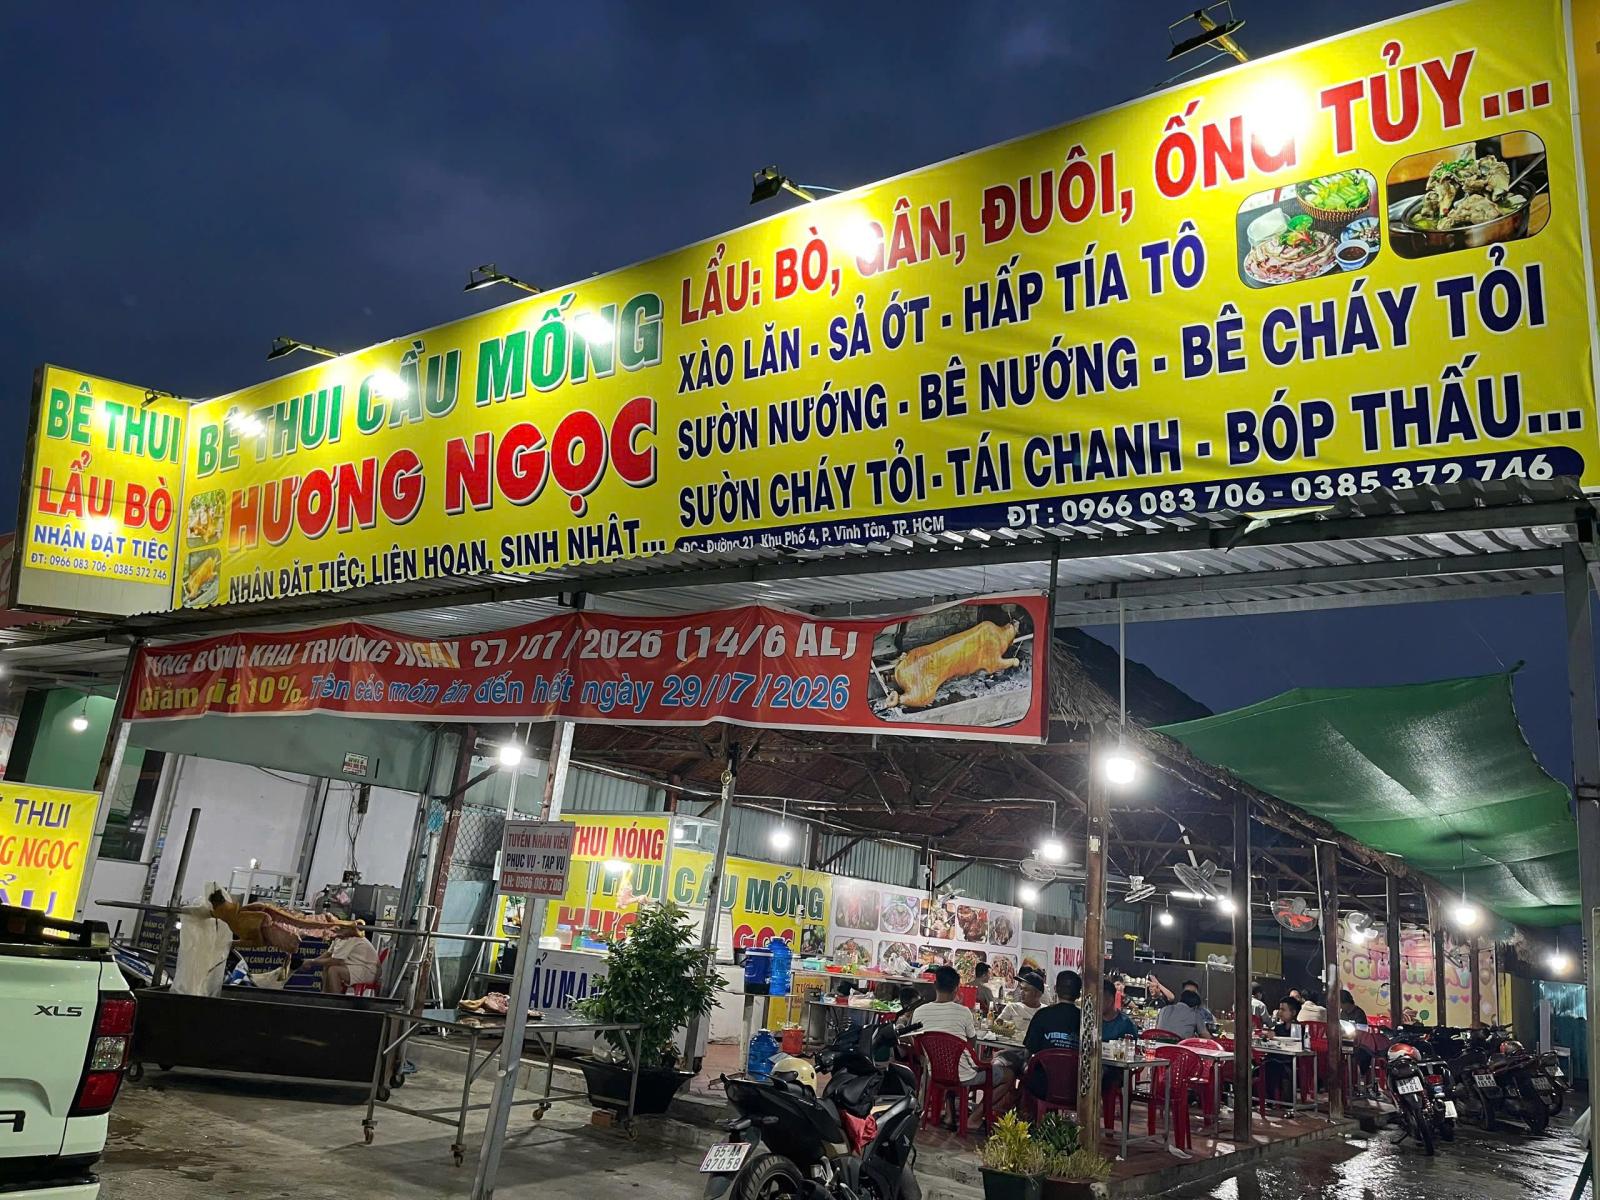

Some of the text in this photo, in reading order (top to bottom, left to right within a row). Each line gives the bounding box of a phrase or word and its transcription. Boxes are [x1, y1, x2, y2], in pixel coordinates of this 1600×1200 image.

[682, 242, 760, 326] LẨU:
[774, 225, 841, 297] BÒ,
[981, 144, 1134, 245] ĐUÔI,
[1320, 41, 1551, 154] TỦY...
[677, 339, 734, 394] XÀO
[744, 322, 801, 379] LĂN
[828, 295, 871, 361] SẢ
[881, 290, 931, 350] ỚT
[964, 254, 1044, 333] HẤP
[1055, 242, 1129, 314] TÍA
[1141, 219, 1206, 295] TÔ
[677, 401, 758, 461] SƯỜN
[768, 380, 888, 445] NƯỚNG
[920, 356, 968, 421] BÊ
[980, 335, 1139, 411] NƯỚNG
[1181, 303, 1247, 380] BÊ
[1261, 278, 1418, 367] CHÁY
[1436, 244, 1546, 339] TỎI
[197, 292, 663, 478] BÊ THUI CẦU MỐNG
[46, 380, 182, 465] BÊ THUI
[678, 471, 761, 529] SƯỜN
[770, 455, 857, 518] CHÁY
[1023, 418, 1182, 489] CHANH
[1225, 388, 1335, 466] BÓP
[1351, 353, 1583, 453] THẤU...
[37, 449, 173, 534] LẨU BÒ
[228, 396, 658, 553] HƯƠNG NGỌC
[1061, 494, 1133, 522] 0966
[1139, 488, 1197, 515] 083
[1205, 481, 1266, 509] 706
[1291, 470, 1381, 502] 0385
[1391, 462, 1463, 491] 372
[1476, 453, 1554, 482] 746
[34, 524, 85, 553] NHẬN
[131, 537, 169, 564] TIỆC
[761, 533, 783, 548] Khu
[784, 525, 808, 547] Phố
[808, 528, 820, 545] 4,
[822, 528, 833, 542] P.
[835, 524, 862, 541] Vĩnh
[863, 521, 890, 539] Tân,
[912, 515, 945, 533] HCM
[31, 552, 47, 565] ĐT:
[49, 554, 71, 568] 0966
[73, 557, 89, 570] 083
[92, 560, 107, 573] 706
[113, 563, 134, 576] 0385
[135, 566, 151, 578] 372
[152, 568, 167, 580] 746
[371, 543, 418, 584] LIÊN
[500, 530, 560, 569] SINH
[249, 642, 300, 667] KHAI
[676, 624, 786, 663] (14/6
[138, 681, 199, 711] Giảm
[248, 675, 302, 704] 10%
[354, 673, 384, 701] các
[388, 678, 439, 703] món
[440, 679, 473, 704] ăn
[474, 670, 525, 704] đến
[531, 668, 575, 703] hết
[580, 672, 655, 713] ngày
[660, 671, 850, 711] 29/07/2026
[15, 798, 72, 829] THUI
[16, 836, 80, 876] NGỌC
[505, 853, 526, 871] PHỤC
[526, 854, 537, 872] VỤ
[542, 855, 555, 873] TẠP
[555, 855, 567, 874] VỤ
[612, 821, 665, 861] NÓNG
[503, 874, 515, 888] LH:
[744, 871, 826, 922] MỐNG
[33, 1004, 84, 1018] XLS
